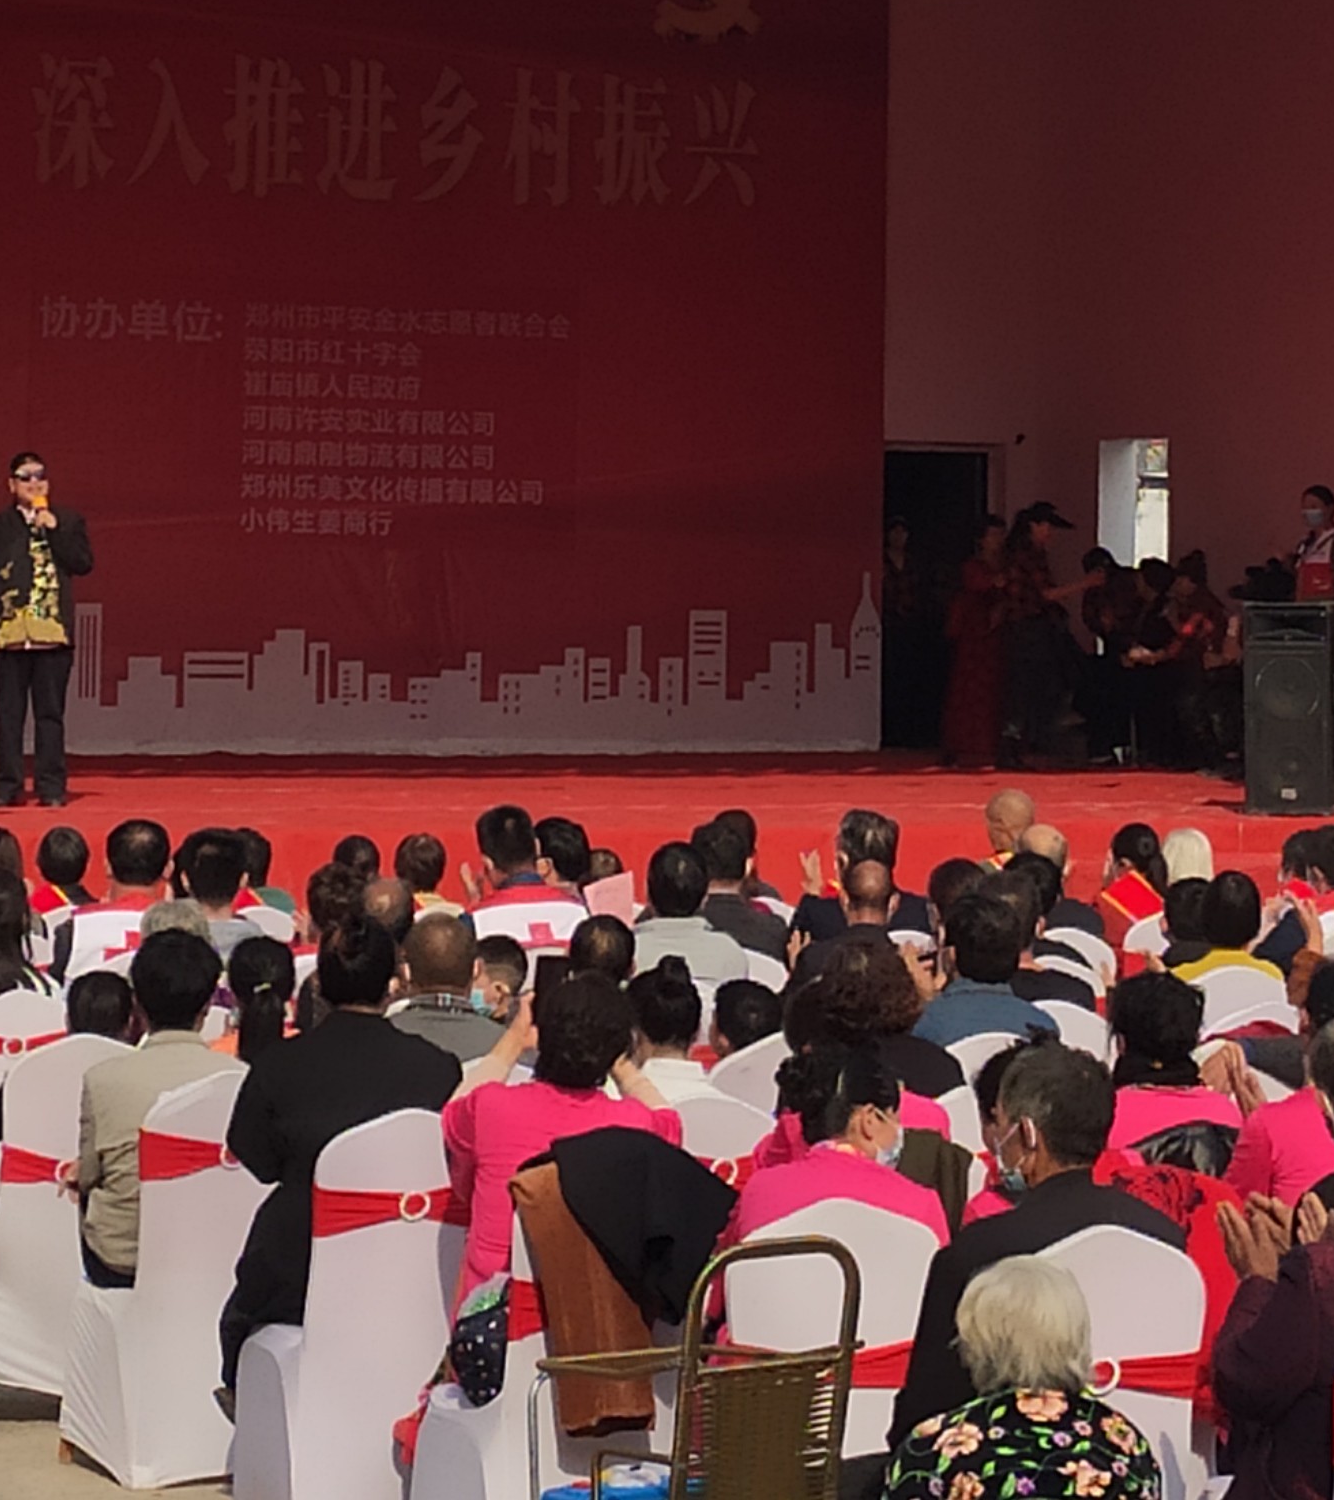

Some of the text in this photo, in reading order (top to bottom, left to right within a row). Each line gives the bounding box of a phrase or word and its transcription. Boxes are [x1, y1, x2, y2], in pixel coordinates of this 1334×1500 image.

[31, 50, 762, 207] 深入推进乡村振兴
[244, 302, 571, 339] 郑州市平安金水志愿者联合会
[243, 336, 423, 367] 荥阳市红十字会
[242, 370, 421, 401] 崔庙镇人民政府
[241, 404, 495, 437] 河南许安实业有限公司
[239, 472, 544, 506] 郑州乐美文化传播有限公司
